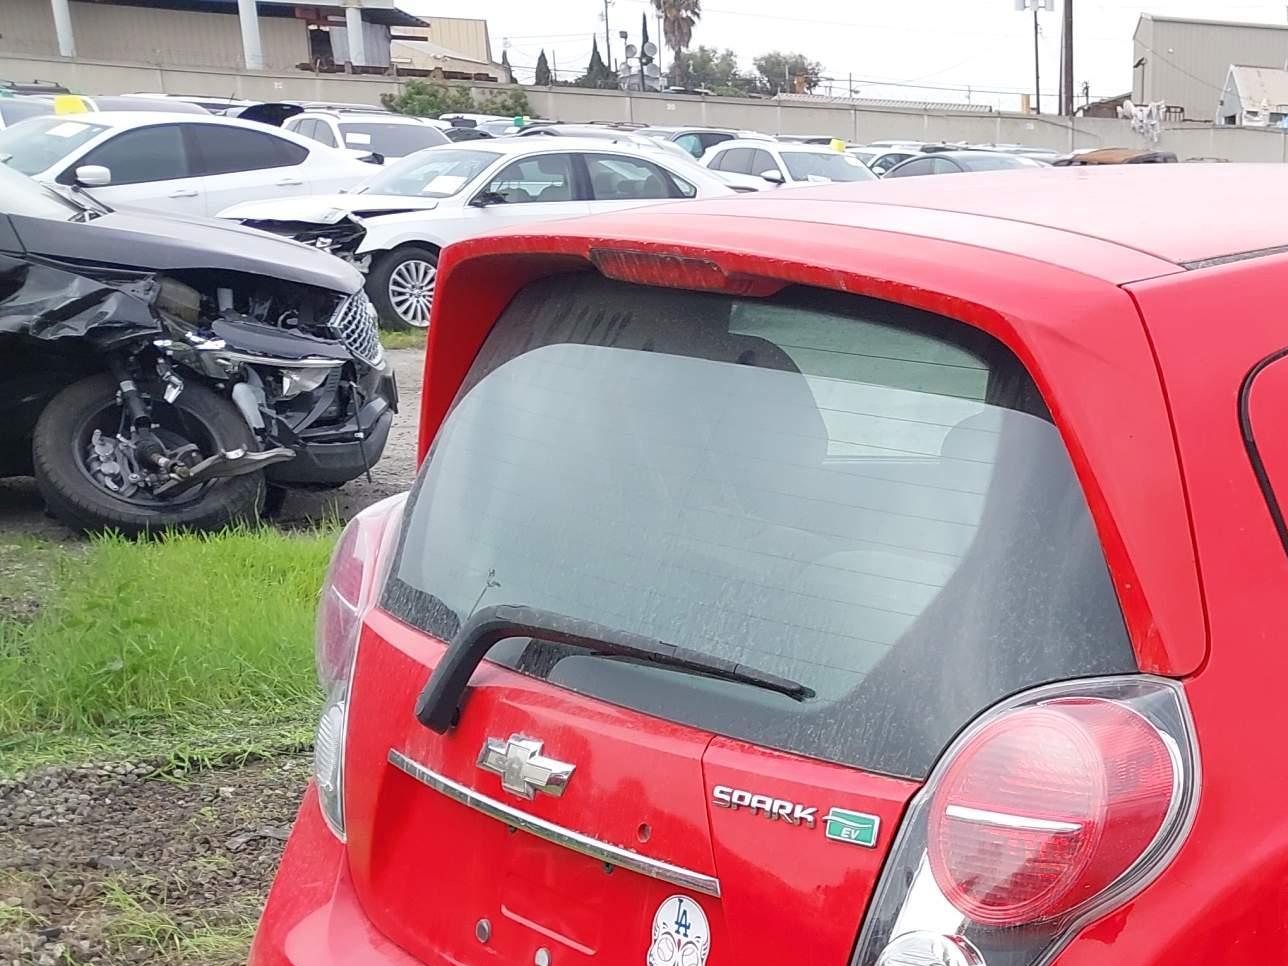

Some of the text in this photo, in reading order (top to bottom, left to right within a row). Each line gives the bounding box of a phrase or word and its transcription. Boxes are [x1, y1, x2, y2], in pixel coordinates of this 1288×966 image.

[712, 785, 817, 829] SPARK
[840, 827, 860, 840] EV
[674, 898, 691, 938] LA
